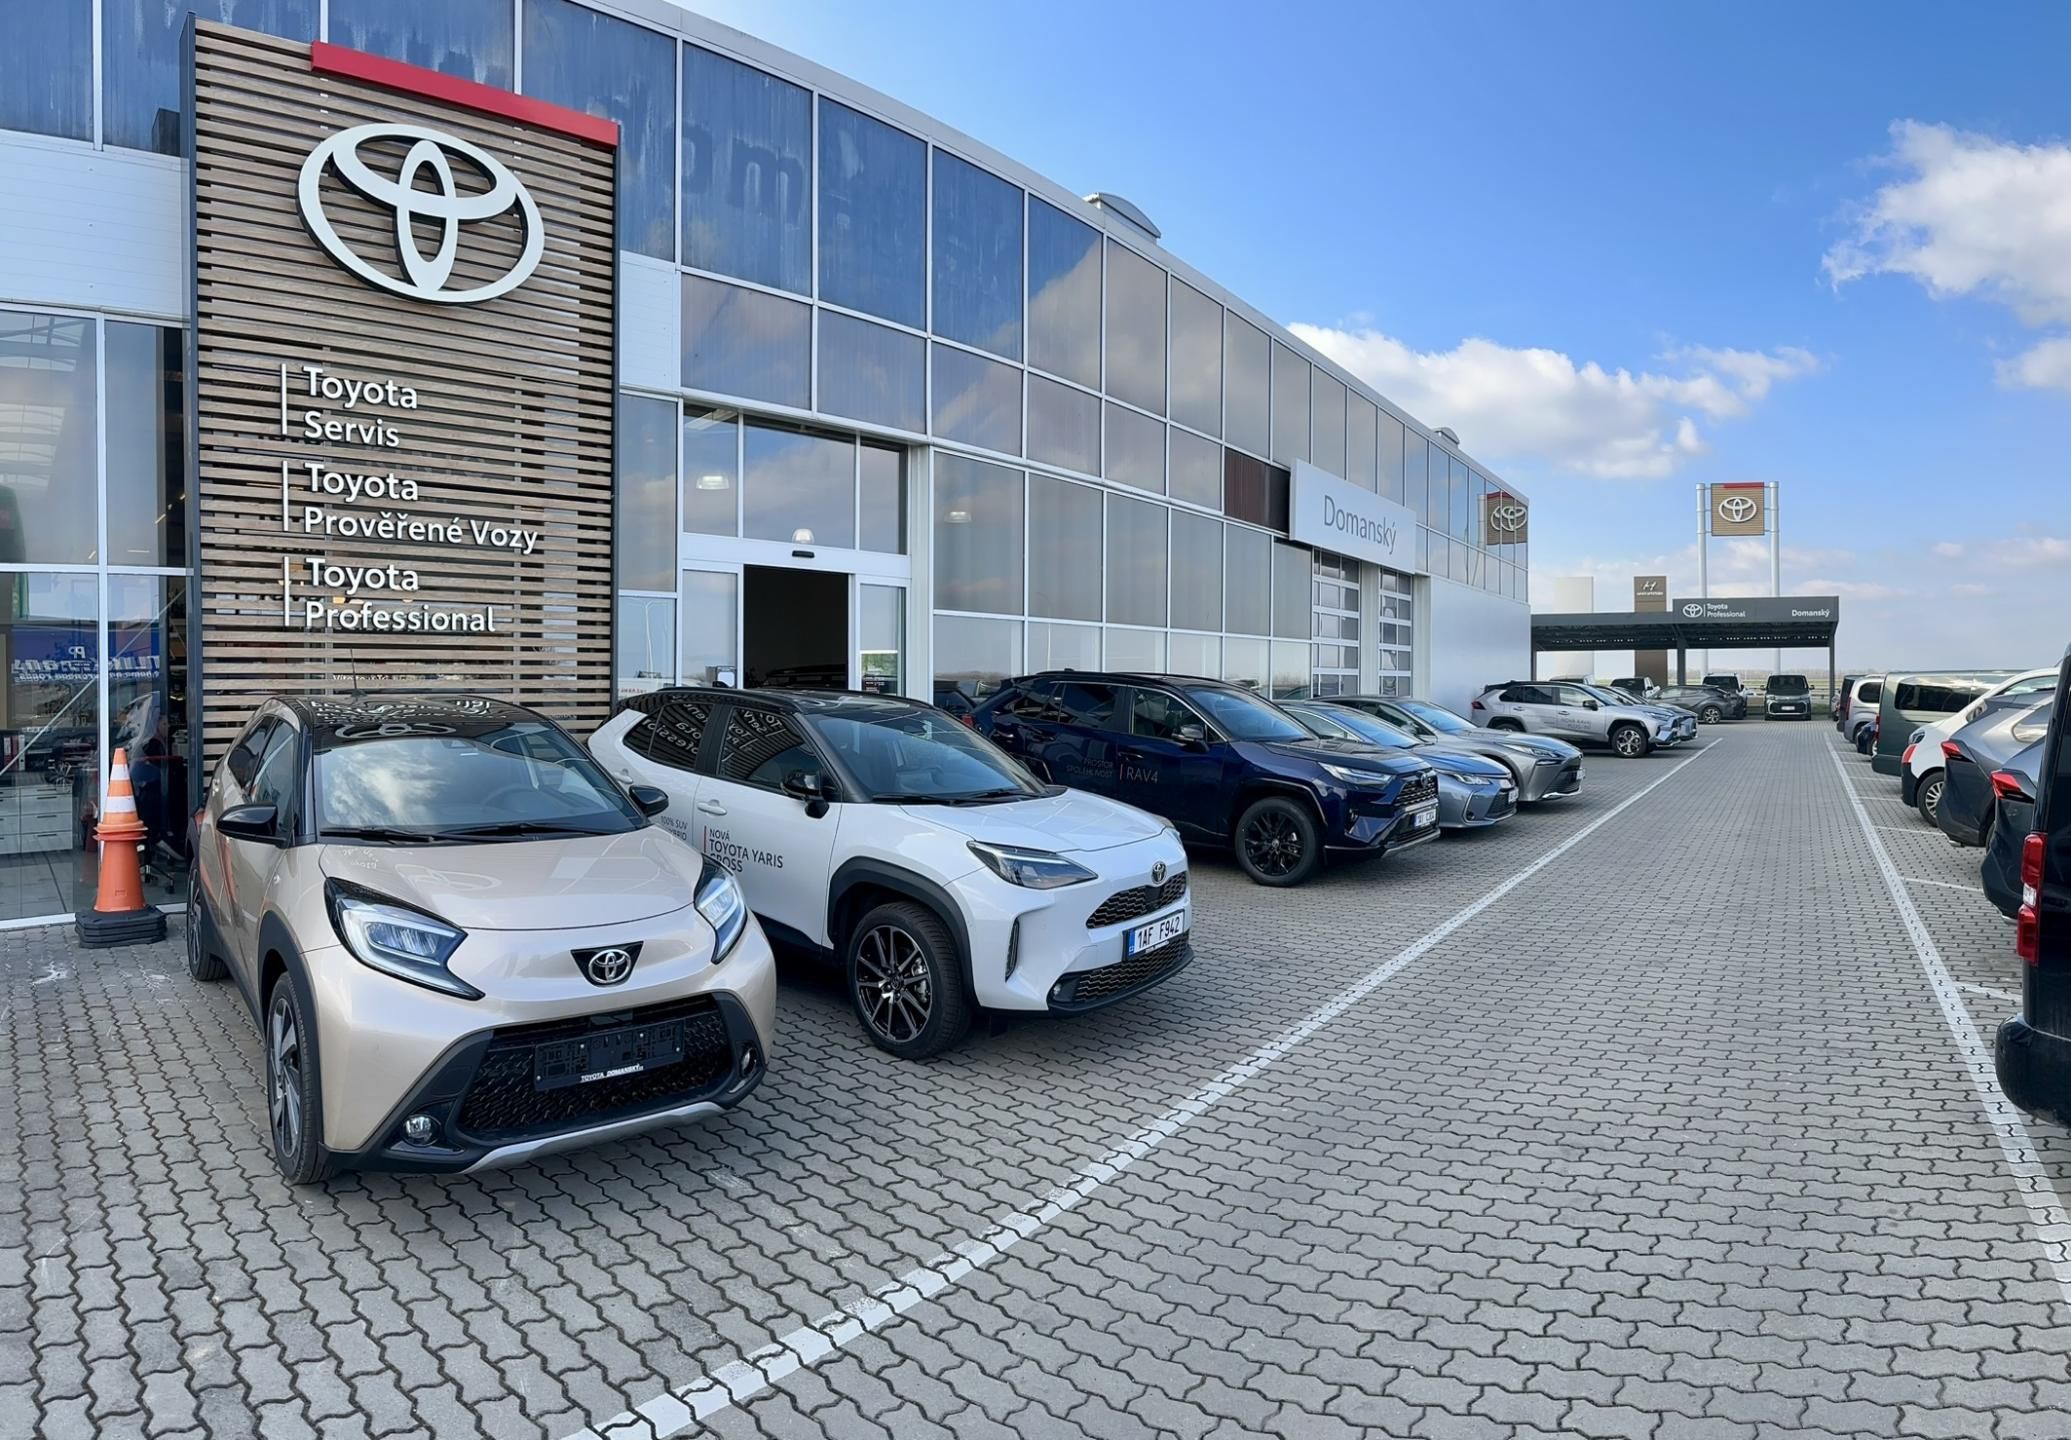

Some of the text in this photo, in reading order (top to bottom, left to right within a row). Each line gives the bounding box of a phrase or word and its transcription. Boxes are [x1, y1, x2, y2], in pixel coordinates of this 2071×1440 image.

[303, 366, 418, 409] Toyota
[304, 411, 400, 447] Servis
[304, 462, 419, 502] Toyota
[304, 506, 538, 554] Prověřené Vozy
[1324, 494, 1397, 555] Domanský
[305, 558, 419, 595] Toyota
[305, 601, 496, 632] Professional
[1707, 603, 1728, 611] Toyota
[1707, 610, 1746, 618] Professional
[1791, 608, 1830, 618] Domanský
[1126, 766, 1159, 785] RAV4
[709, 828, 730, 841] NOVÁ
[709, 839, 783, 869] TOYOTA YARIS
[1137, 916, 1180, 949] 1AF F942
[580, 1072, 605, 1083] TOYOTA
